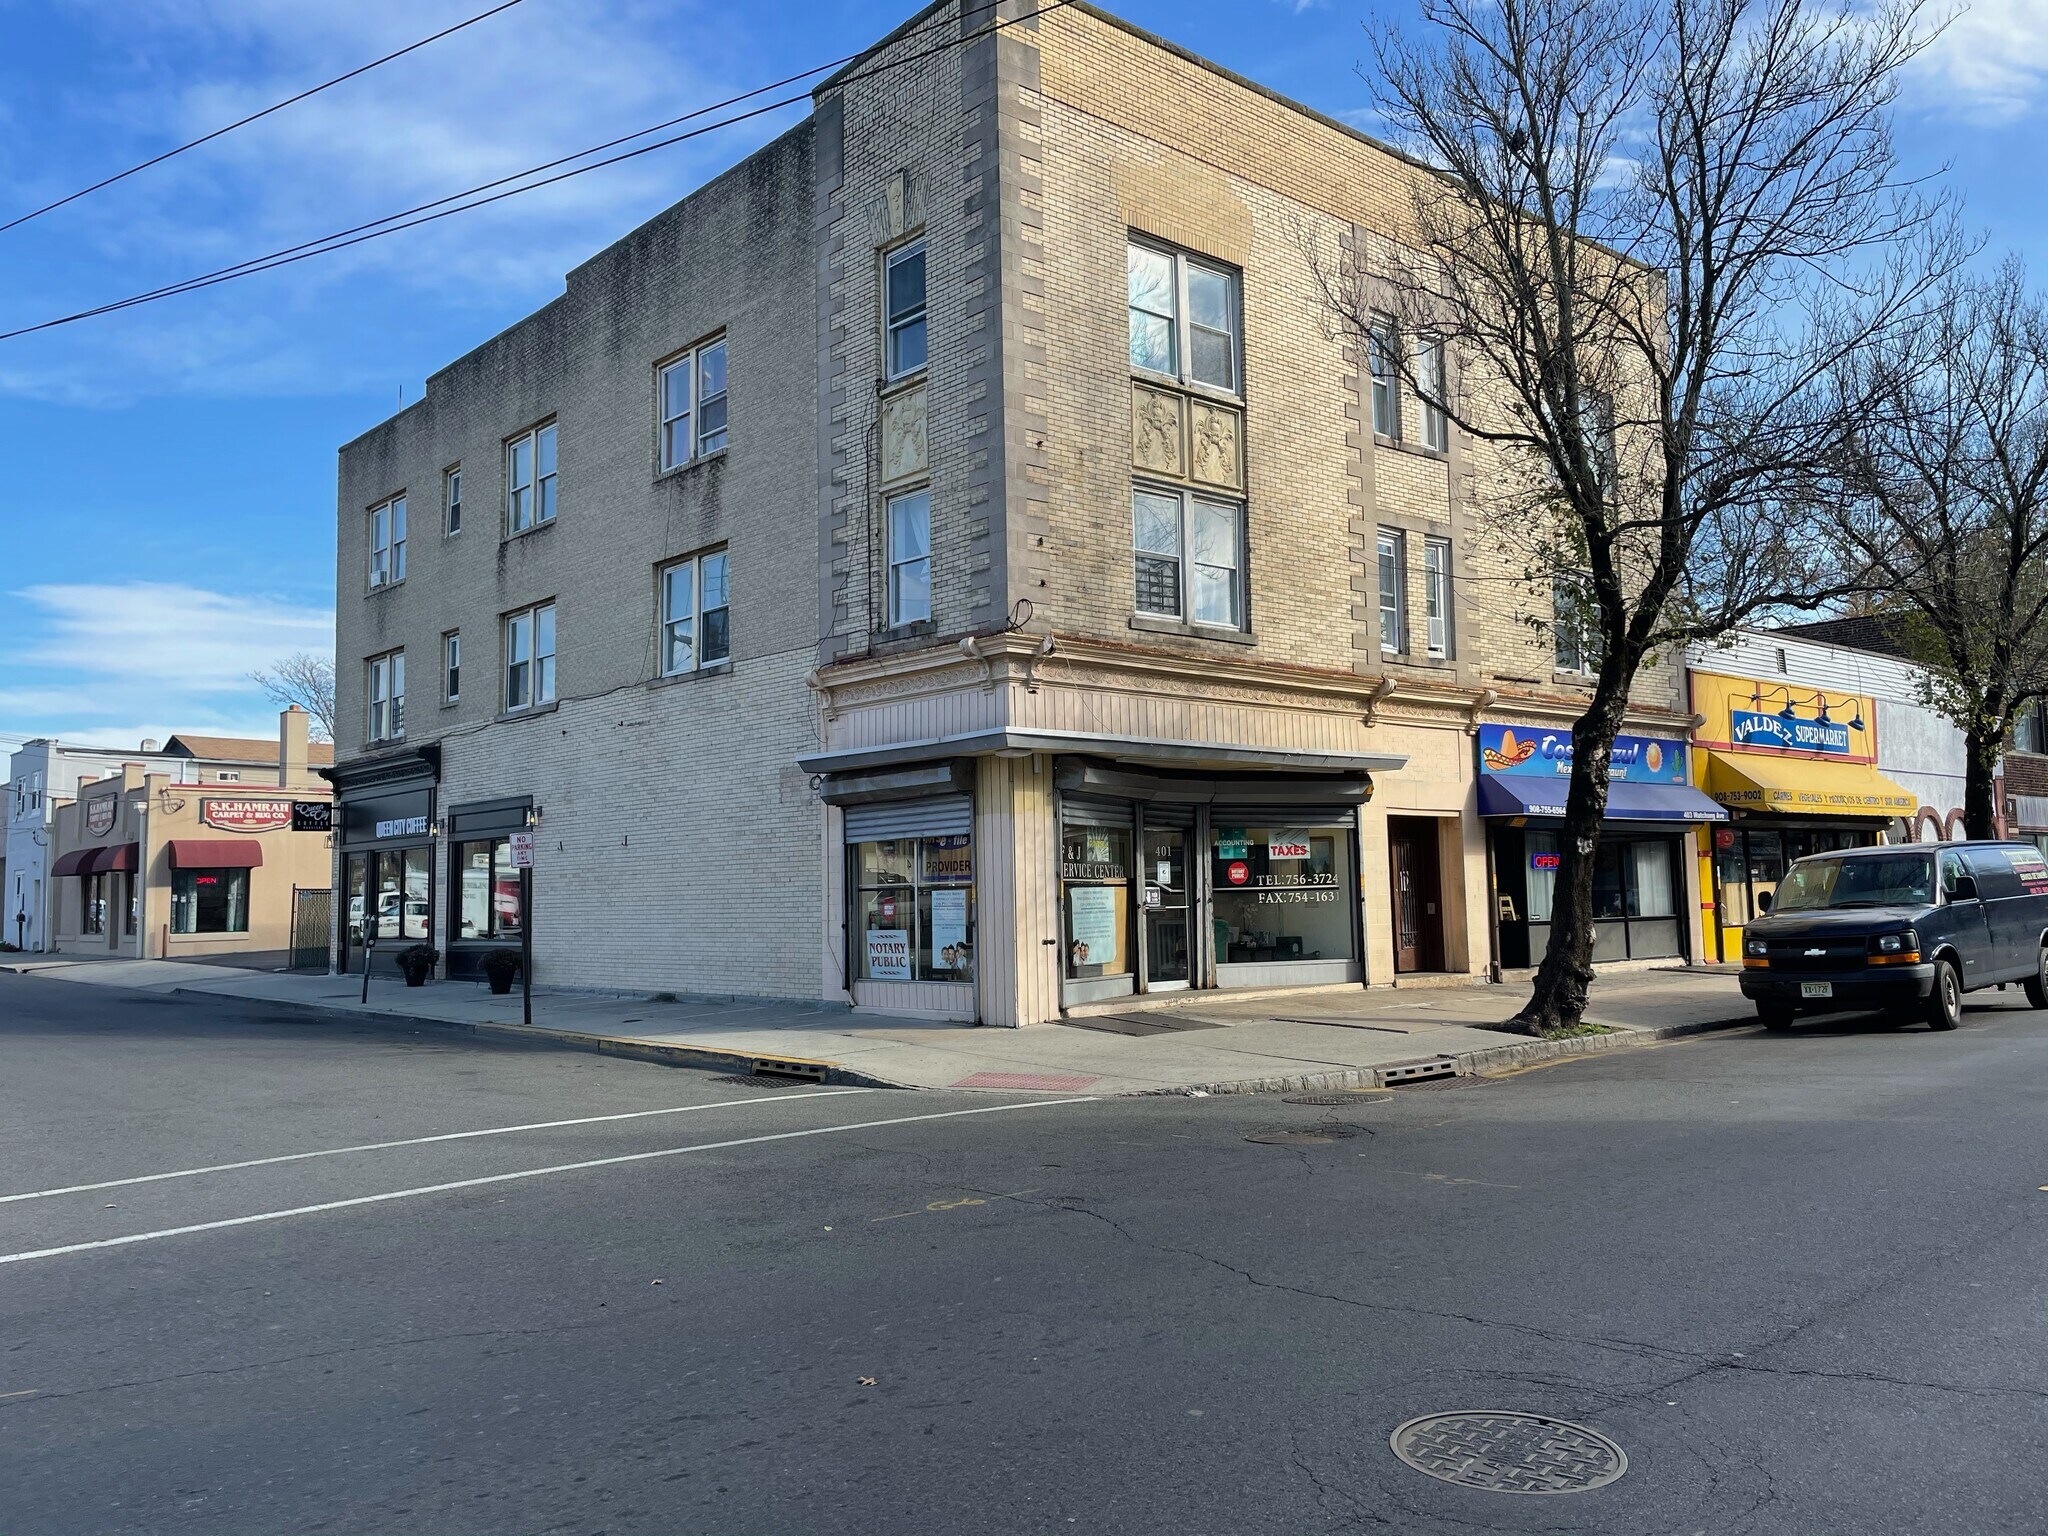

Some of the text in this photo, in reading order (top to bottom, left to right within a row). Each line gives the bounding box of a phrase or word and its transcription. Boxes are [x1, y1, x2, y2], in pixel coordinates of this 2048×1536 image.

[1735, 716, 1847, 747] VALDEZ SUPERMARKET
[1541, 735, 1640, 765] Cos zul
[1714, 790, 1762, 801] 908-753-9002
[210, 802, 289, 812] S.K.HAMRAH
[406, 816, 428, 835] COFFEE
[517, 835, 526, 843] NO
[1214, 839, 1254, 847] ACCOUNTING
[511, 843, 532, 851] PARKING
[1076, 846, 1081, 860] J
[1155, 846, 1172, 857] 401
[1270, 845, 1308, 857] TAXES
[926, 860, 971, 873] PROVIDER
[1535, 856, 1560, 867] OPEN
[1063, 862, 1125, 879] ERVICE CENTER
[869, 942, 906, 954] NOTARY
[871, 956, 907, 968] PUBLIC
